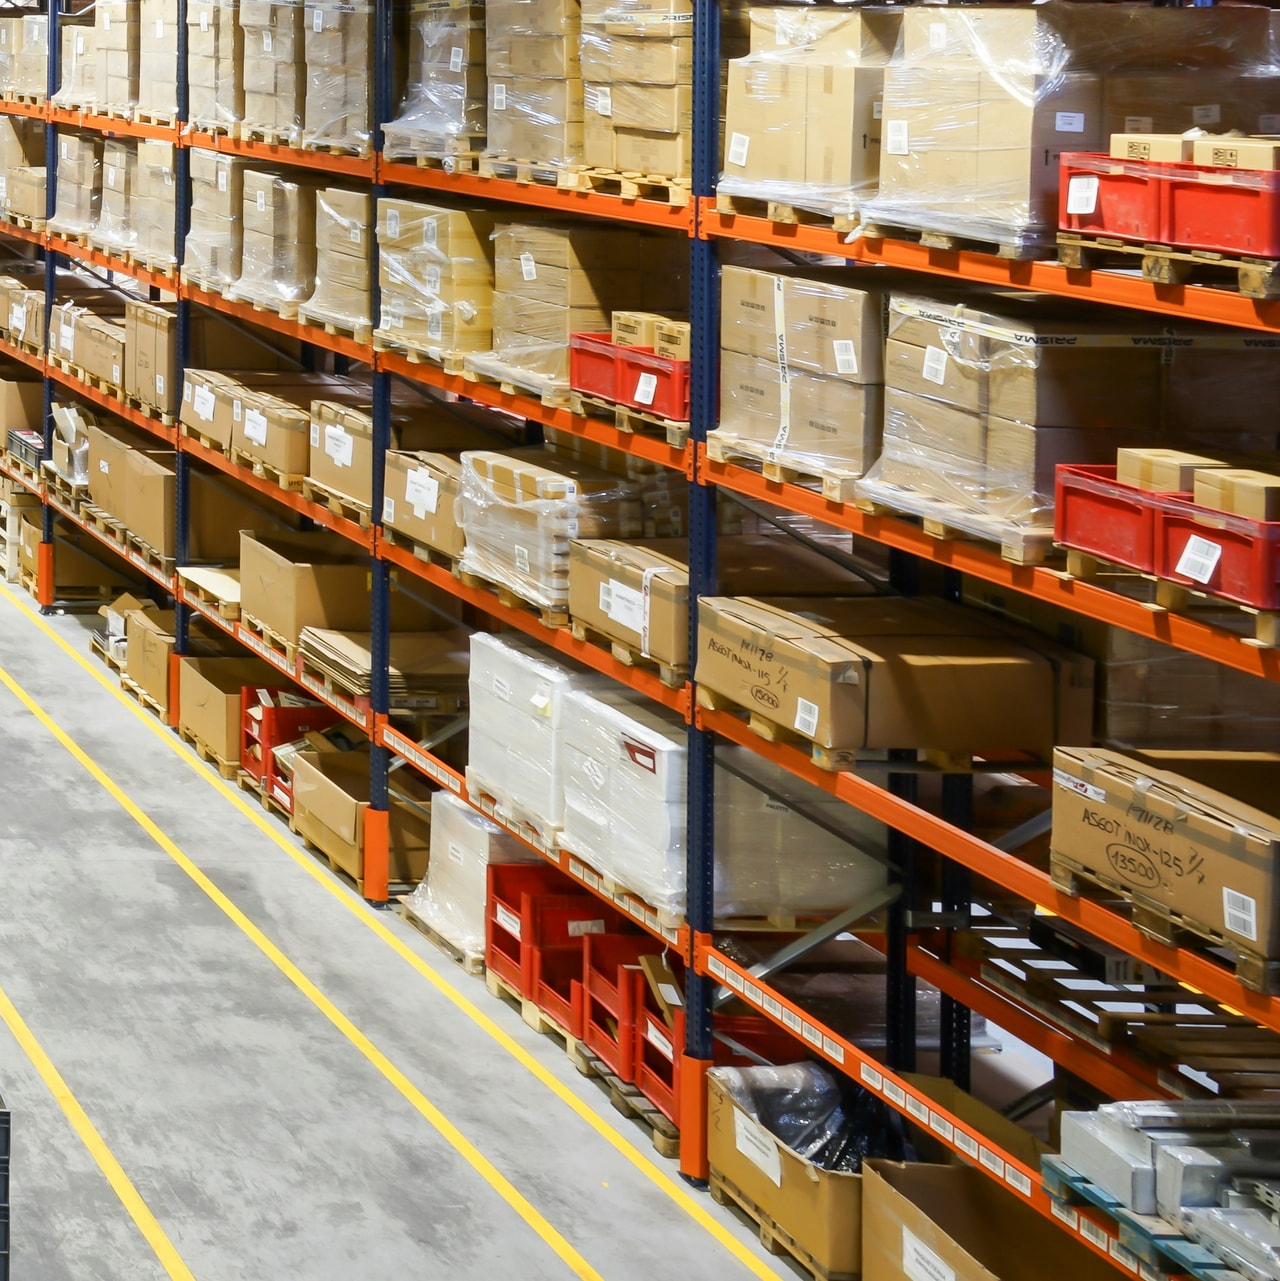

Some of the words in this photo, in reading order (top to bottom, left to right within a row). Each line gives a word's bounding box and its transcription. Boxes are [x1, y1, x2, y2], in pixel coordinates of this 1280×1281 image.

[1014, 333, 1078, 346] PRISMA
[778, 333, 788, 384] PRISMA
[1111, 850, 1155, 881] 13500
